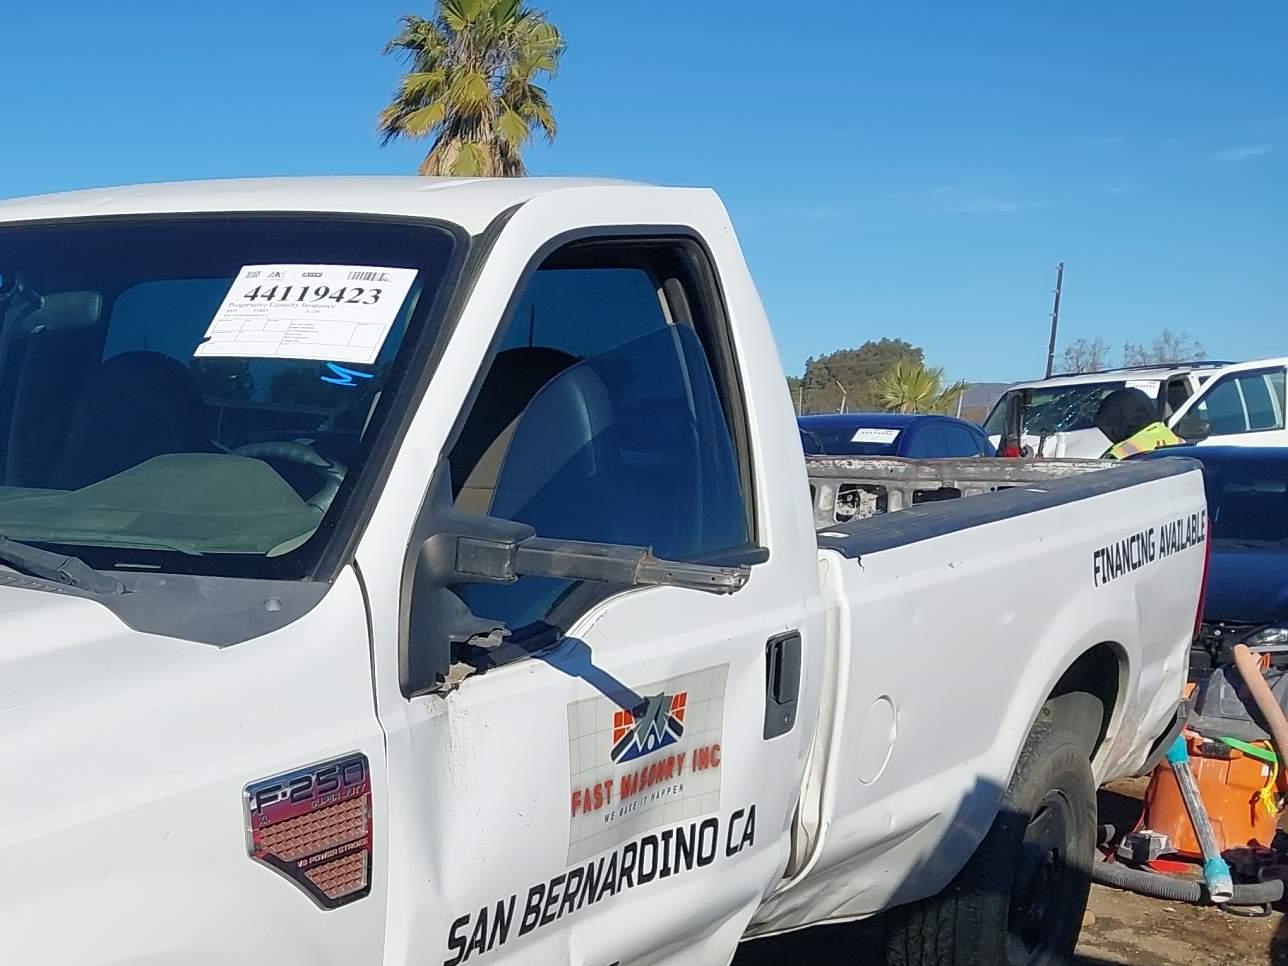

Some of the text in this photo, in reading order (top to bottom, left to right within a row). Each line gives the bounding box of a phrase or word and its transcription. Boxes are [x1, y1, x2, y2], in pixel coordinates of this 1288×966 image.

[244, 285, 383, 305] 44119423
[1093, 510, 1205, 587] FINANCING AVAILABLE
[254, 760, 366, 815] F-250
[571, 744, 721, 817] FAST MASONRY INC
[604, 811, 615, 823] WE
[619, 801, 637, 817] MAKE
[650, 784, 684, 801] HAPPEN
[308, 848, 338, 864] POWER
[338, 837, 369, 854] STROKE
[518, 817, 719, 937] BERNARDINO
[725, 803, 757, 858] CA
